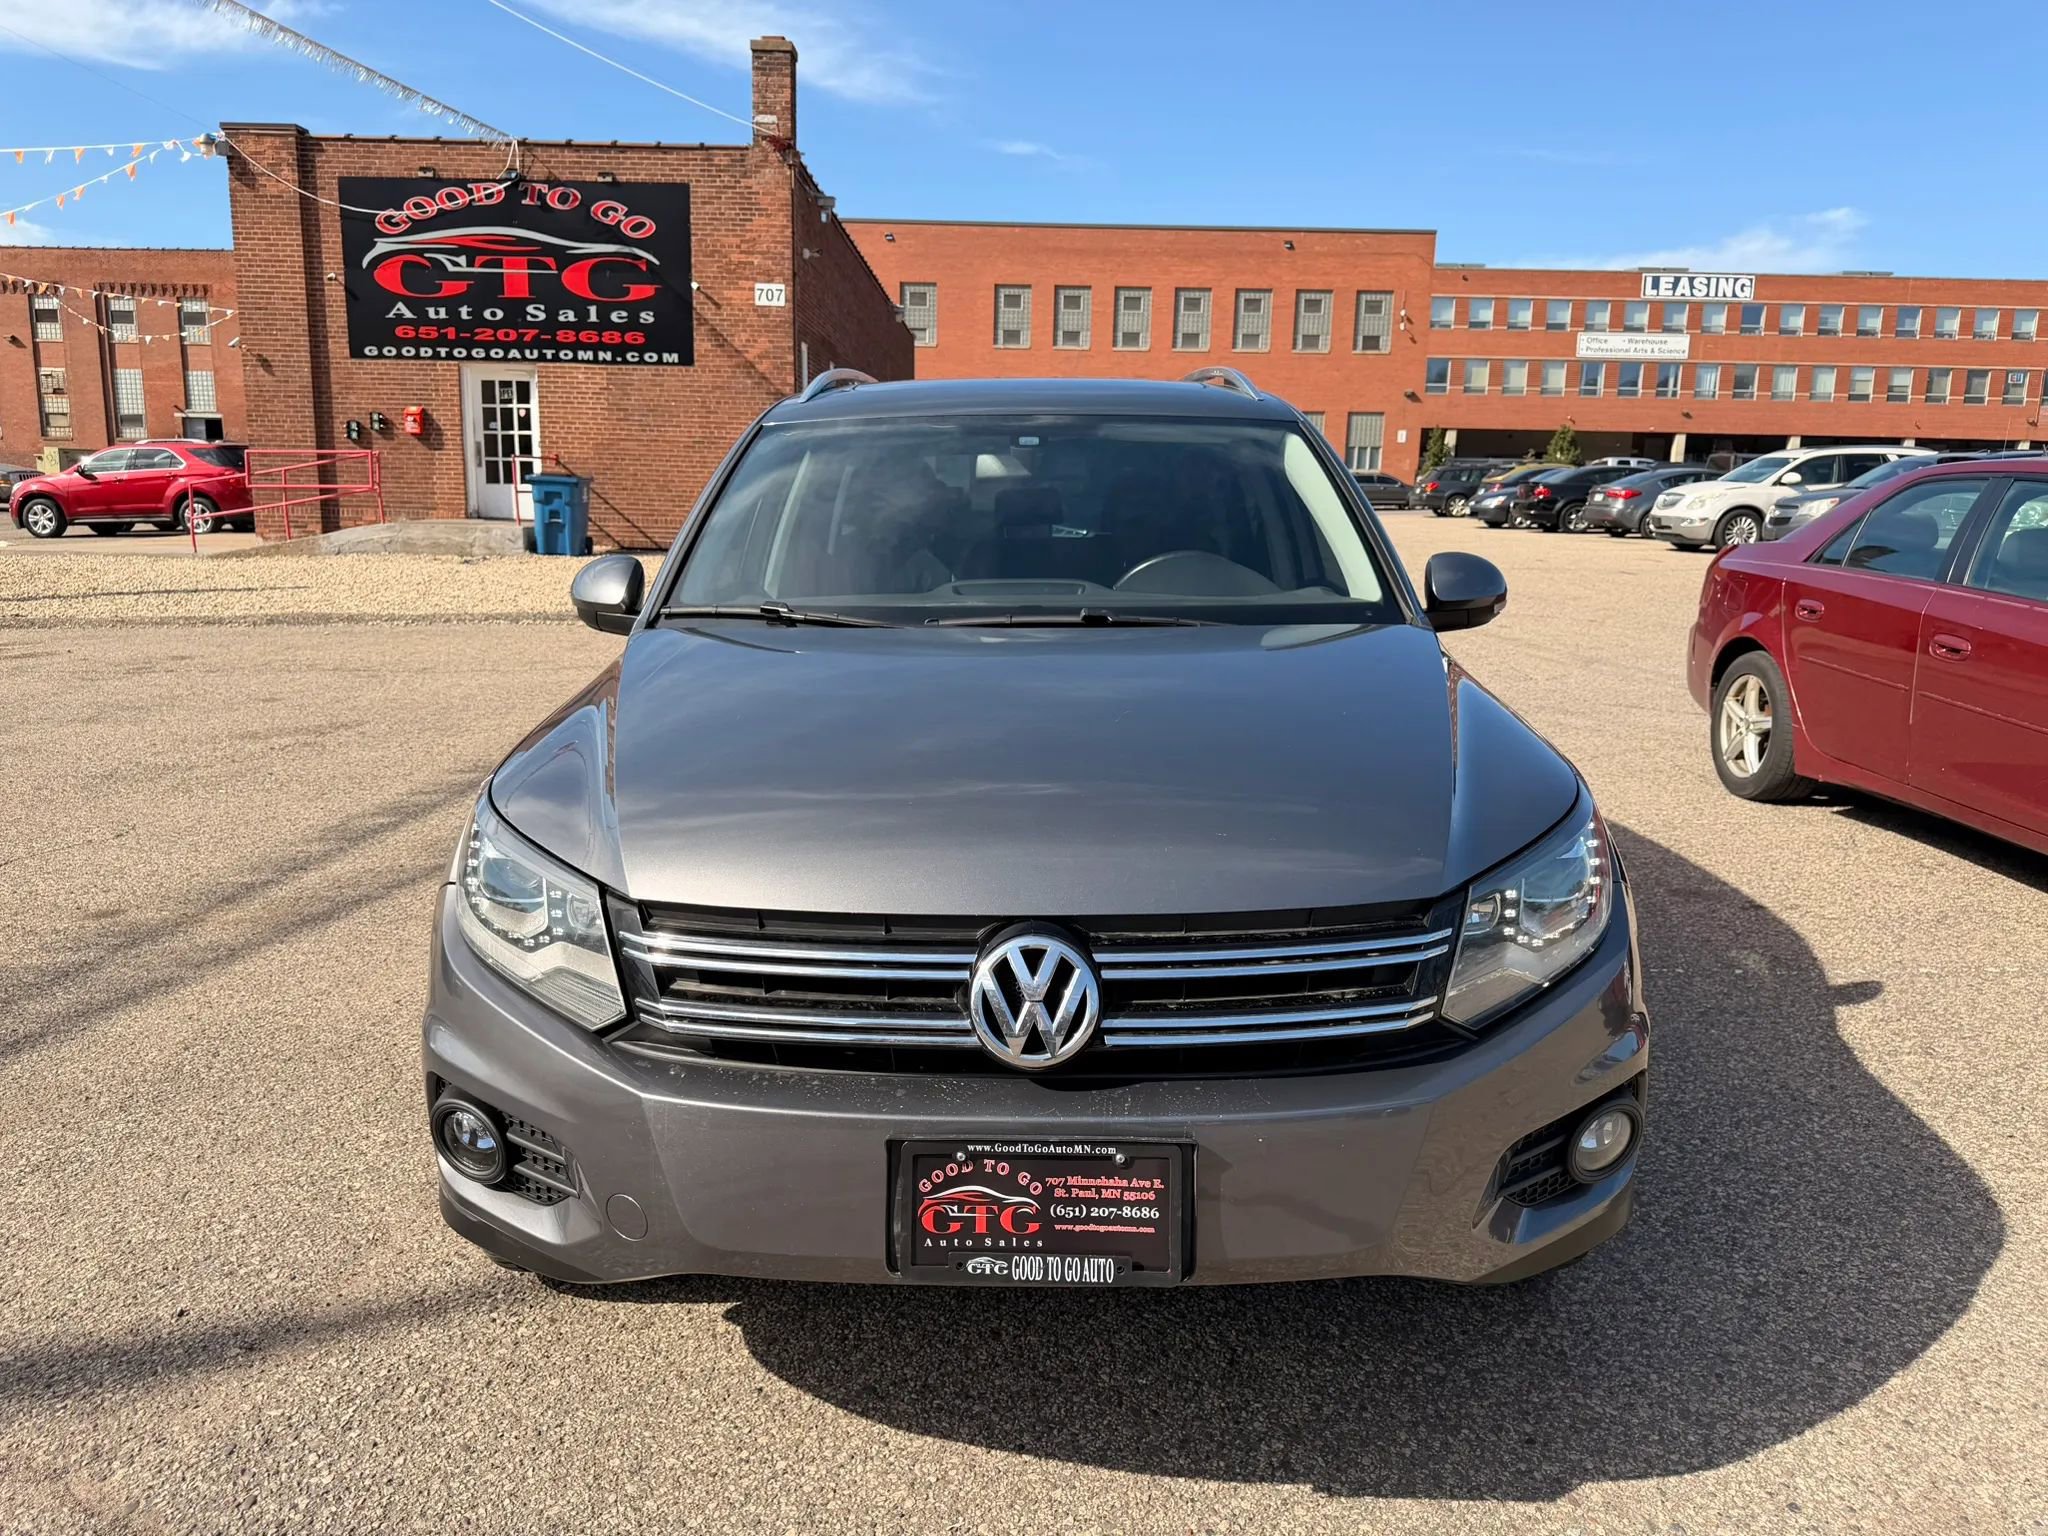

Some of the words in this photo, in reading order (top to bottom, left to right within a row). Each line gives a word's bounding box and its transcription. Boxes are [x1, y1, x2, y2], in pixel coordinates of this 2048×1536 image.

[375, 182, 505, 234] GOOD
[519, 182, 582, 210] TO
[590, 200, 657, 239] GO
[373, 254, 662, 302] GTG
[1645, 276, 1751, 297] LEASING
[756, 288, 783, 302] 707
[385, 301, 504, 322] Auto
[526, 304, 656, 324] Sales
[394, 325, 646, 345] 651-207-8686
[1586, 336, 1608, 344] Office
[1627, 337, 1668, 346] Warehouse
[363, 345, 680, 365] GOODTOGOAUTOMN.COM
[1585, 344, 1631, 353] Professional
[1633, 346, 1648, 354] Arts
[1657, 347, 1687, 355] Science
[967, 1143, 1117, 1155] www.GoodToGoAutoMN.com
[919, 1161, 974, 1193] GOOD
[983, 1159, 1010, 1175] TO
[1017, 1172, 1043, 1195] GO
[1046, 1178, 1065, 1187] 707
[1130, 1178, 1151, 1188] Ave
[1054, 1188, 1069, 1198] St.
[1071, 1188, 1100, 1200] Paul,
[1101, 1189, 1122, 1199] MN
[1123, 1191, 1156, 1201] 55106
[921, 1205, 1043, 1235] GTG
[1050, 1204, 1087, 1218] (651)
[1090, 1206, 1160, 1220] 207-8686
[924, 1238, 973, 1247] Auto
[984, 1237, 1043, 1247] Sales
[967, 1263, 1009, 1275] GTG
[1011, 1255, 1044, 1281] GOOD
[1046, 1256, 1062, 1282] TO
[1064, 1257, 1081, 1282] GO
[1082, 1257, 1115, 1284] AUTO
